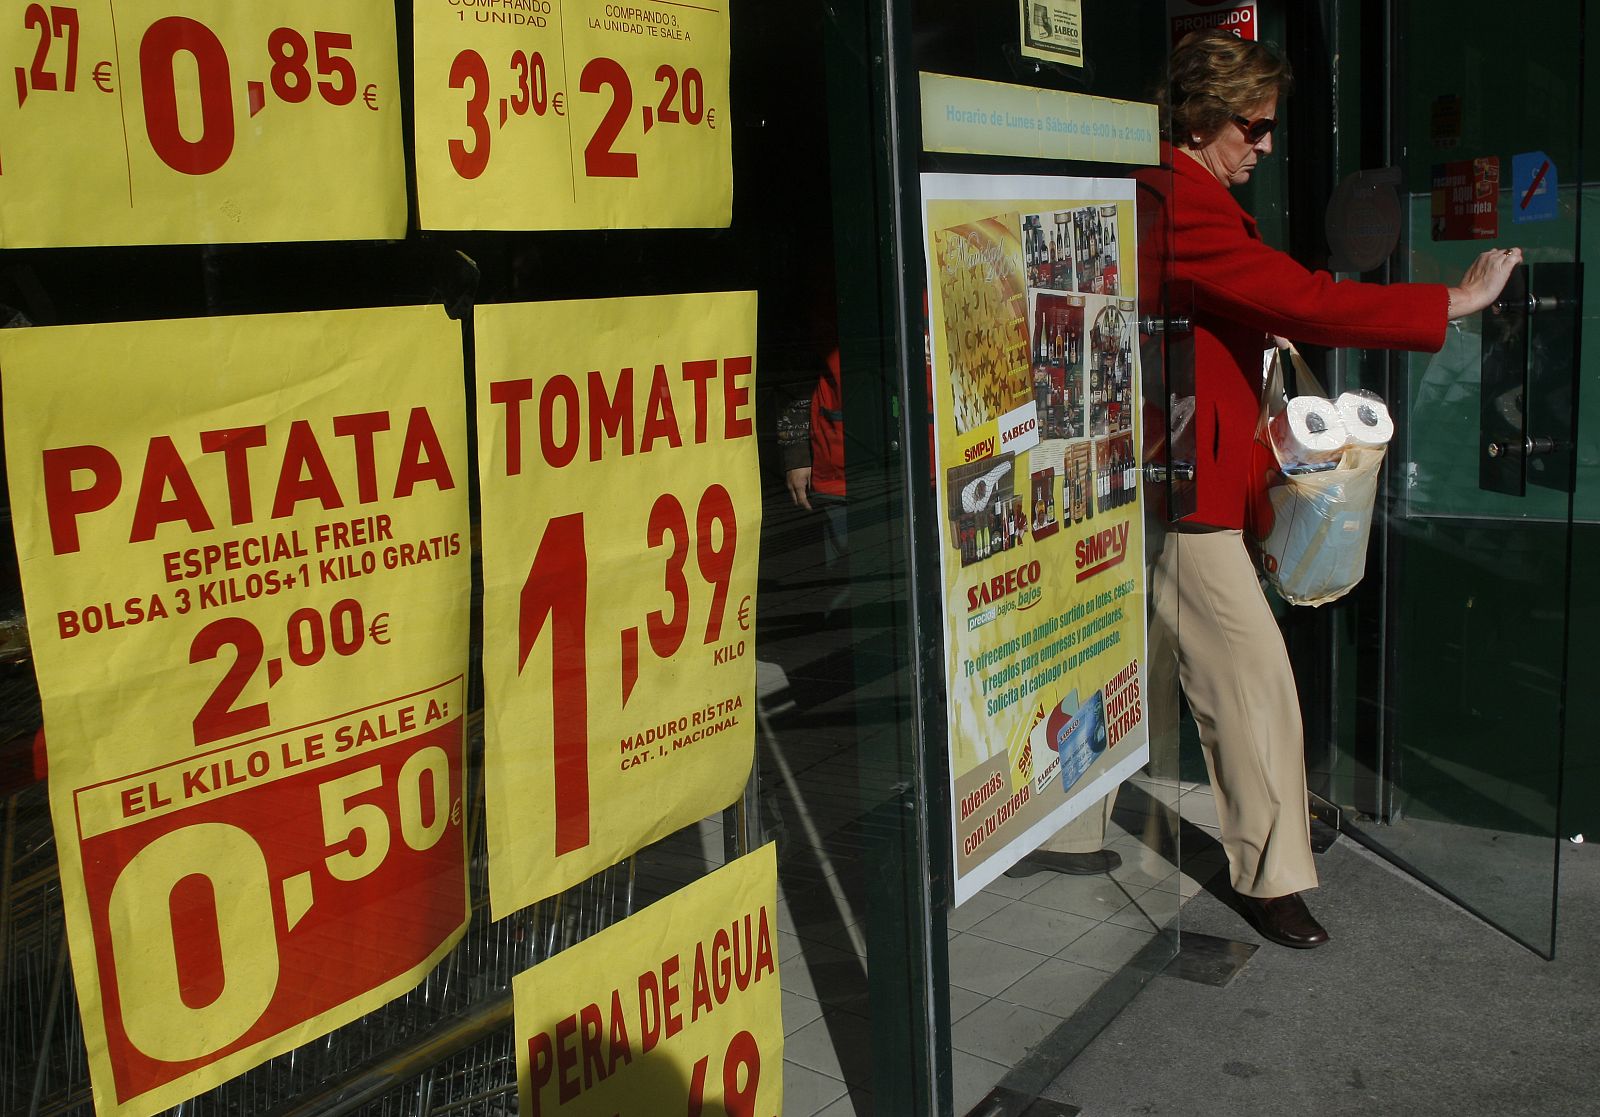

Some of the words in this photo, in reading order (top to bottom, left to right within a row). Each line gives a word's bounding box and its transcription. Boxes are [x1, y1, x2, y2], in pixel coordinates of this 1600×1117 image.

[456, 11, 465, 21] 1
[475, 11, 547, 28] UNIDAD
[588, 17, 601, 29] LA
[604, 19, 643, 35] UNIDAD
[646, 25, 657, 37] TE
[660, 27, 683, 41] SALE
[683, 31, 692, 42] A
[605, 4, 669, 25] COMPRANDO
[671, 16, 680, 28] 3,
[1054, 24, 1079, 38] SABECO
[1175, 9, 1251, 31] PROHIBIDO
[946, 104, 987, 126] Horario
[991, 111, 1003, 127] de
[1006, 113, 1034, 130] Lunes
[1037, 119, 1043, 130] a
[1046, 115, 1077, 135] Sábado
[1080, 121, 1091, 136] de
[1092, 122, 1110, 138] 9:00
[1112, 124, 1117, 139] h
[1119, 127, 1124, 140] a
[1125, 126, 1145, 142] 21:00
[490, 355, 753, 477] TOMATE
[1001, 418, 1036, 444] SABECO
[43, 406, 455, 556] PATATA
[163, 530, 308, 583] ESPECIAL
[315, 514, 394, 553] FREIR
[57, 593, 169, 640] BOLSA
[175, 588, 191, 615] 3
[320, 549, 376, 585] KILO
[382, 532, 461, 571] GRATIS
[967, 560, 1041, 613] SABECO
[1018, 586, 1042, 606] bajos
[713, 639, 745, 666] KILO
[964, 660, 975, 678] Te
[976, 637, 1021, 672] ofrecemos
[1021, 633, 1032, 648] un
[1033, 616, 1059, 645] amplio
[1059, 603, 1085, 630] surtido
[1086, 600, 1095, 614] en
[1113, 578, 1135, 600] cestas
[982, 680, 987, 697] y
[988, 662, 1020, 693] regalos
[1021, 654, 1039, 677] para
[1040, 634, 1076, 667] empresas
[1076, 634, 1081, 649] y
[1082, 608, 1124, 645] particulares.
[987, 688, 1019, 718] Solicita
[1020, 683, 1028, 701] el
[1029, 661, 1062, 694] catálogo
[1062, 664, 1068, 675] o
[1068, 655, 1078, 671] un
[1105, 658, 1138, 700] ACUMULAS
[1106, 677, 1140, 725] PUNTOS
[620, 713, 689, 755] MADURO
[691, 695, 743, 730] RISTRA
[620, 751, 655, 771] CAT.
[672, 716, 739, 751] NACIONAL
[1108, 700, 1142, 750] EXTRAS
[120, 785, 172, 818] EL
[183, 750, 270, 799] KILO
[281, 733, 326, 769] LE
[334, 705, 417, 752] SALE
[424, 699, 448, 725] A:
[1037, 756, 1060, 786] SABECO
[961, 771, 1005, 822] Además,
[964, 826, 984, 856] con
[985, 816, 997, 836] tu
[997, 785, 1030, 826] tarjeta
[527, 988, 633, 1117] PERA
[638, 953, 683, 1055] DE
[691, 905, 775, 1024] AGUA
